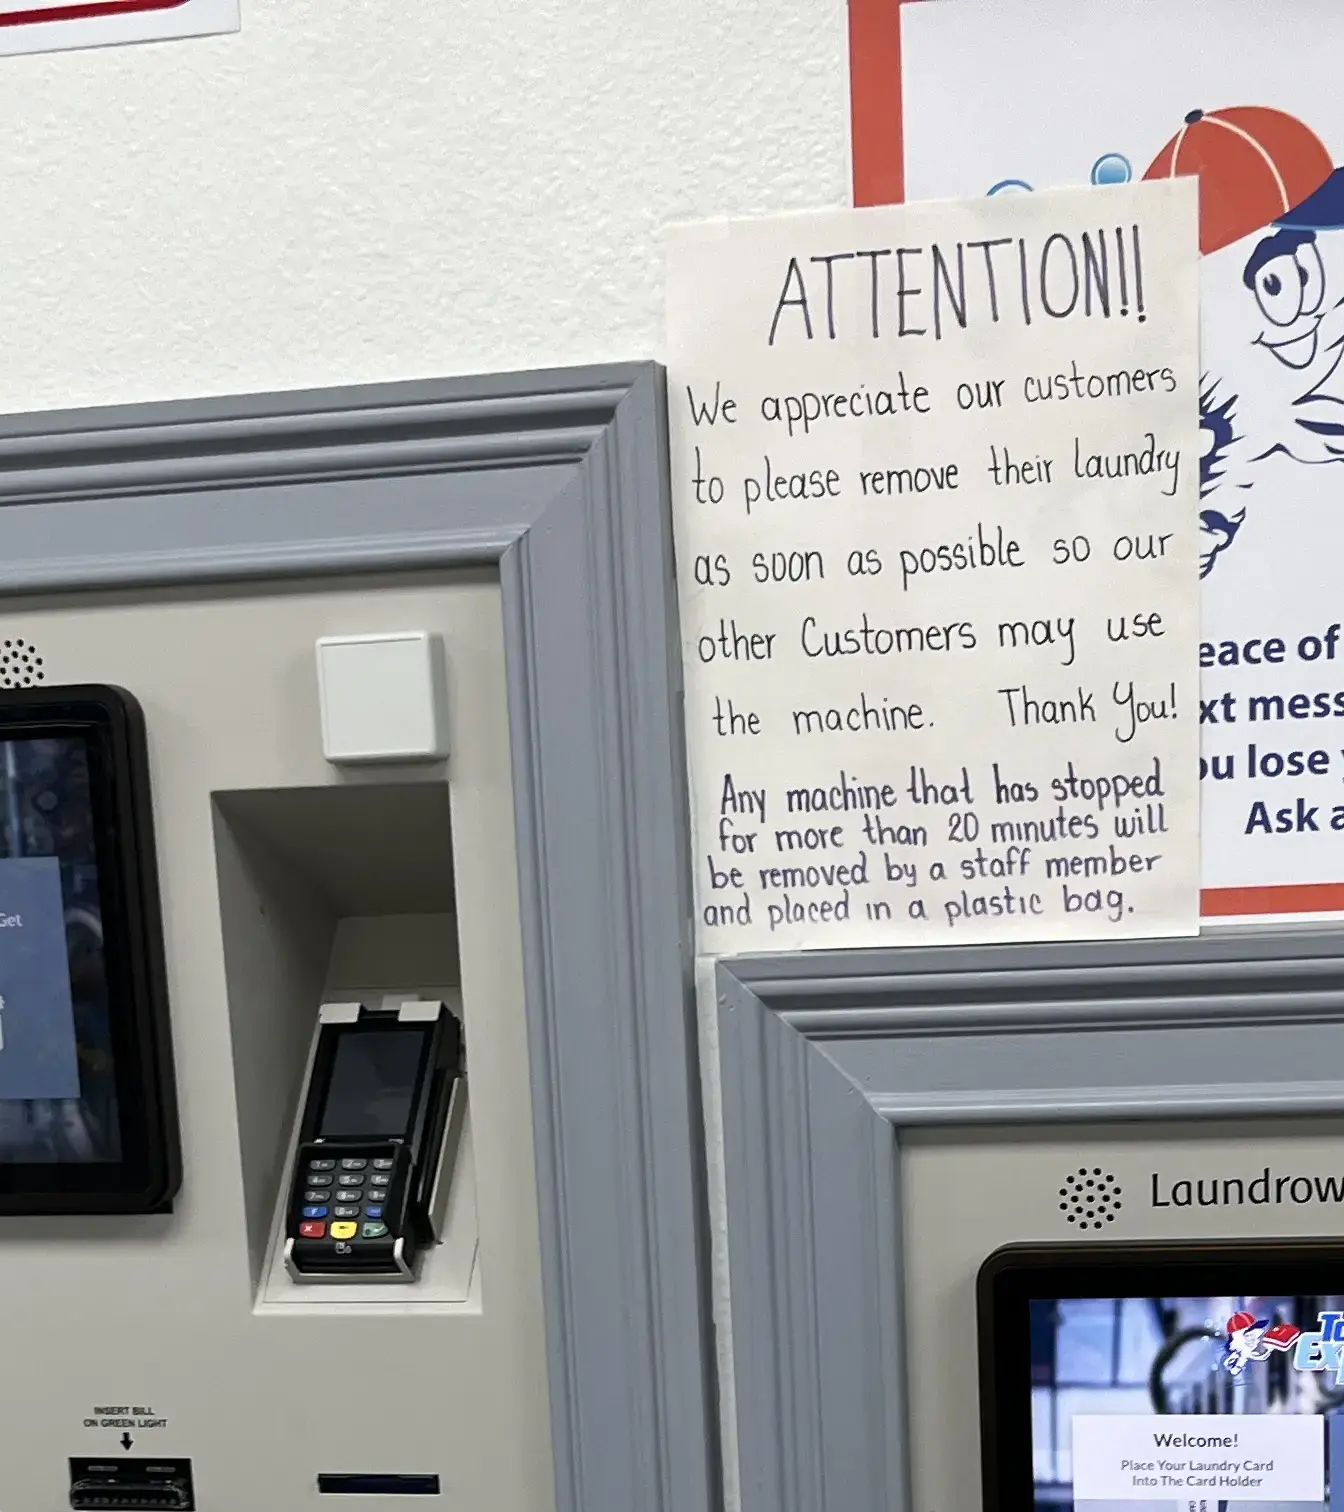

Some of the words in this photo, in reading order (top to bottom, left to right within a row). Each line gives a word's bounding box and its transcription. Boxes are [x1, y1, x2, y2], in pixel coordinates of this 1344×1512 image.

[767, 222, 1148, 347] ATTENTION!!
[685, 380, 738, 428] We
[760, 369, 932, 438] appreciate
[955, 379, 1007, 411] our
[1023, 359, 1178, 404] customers
[690, 444, 725, 505] to
[743, 456, 842, 516] please
[858, 462, 960, 497] remove
[986, 444, 1055, 487] their
[1073, 431, 1182, 498] laundry
[693, 553, 732, 588] as
[751, 550, 826, 584] soon
[846, 548, 883, 577] as
[898, 521, 1027, 592] possible
[1051, 534, 1092, 565] so
[1112, 532, 1174, 562] our
[696, 618, 778, 665] other
[800, 611, 978, 659] Customers
[997, 616, 1076, 668] may
[1106, 611, 1167, 642] use
[1199, 636, 1287, 669] eace
[1296, 622, 1342, 663] of
[711, 694, 762, 738] the
[792, 690, 935, 735] machine.
[997, 684, 1098, 728] Thank
[1111, 680, 1179, 744] You!
[1247, 742, 1331, 780] lose
[719, 772, 767, 825] Any
[785, 768, 899, 813] machine
[906, 764, 975, 807] that
[993, 762, 1040, 805] has
[1050, 756, 1165, 811] stopped
[1243, 796, 1321, 836] Ask
[717, 816, 759, 855] for
[775, 825, 845, 851] more
[861, 812, 929, 847] than
[947, 811, 980, 844] 20
[990, 811, 1100, 843] minutes
[1113, 801, 1170, 838] will
[706, 854, 745, 891] be
[758, 849, 871, 891] removed
[884, 851, 918, 885] by
[928, 861, 948, 883] a
[959, 845, 1033, 881] staff
[1045, 843, 1163, 879] member
[702, 890, 753, 928] and
[767, 889, 851, 929] placed
[865, 900, 893, 921] in
[907, 898, 928, 921] a
[944, 885, 1044, 928] plastic
[1061, 883, 1135, 921] bag.
[1154, 1433, 1238, 1448] Welcome!
[1121, 1460, 1154, 1471] Place
[1156, 1460, 1186, 1471] Your
[1189, 1460, 1240, 1473] Laundry
[1243, 1460, 1274, 1471] Card
[1132, 1475, 1157, 1486] Into
[1160, 1475, 1184, 1486] The
[1186, 1476, 1216, 1487] Card
[1219, 1476, 1263, 1487] Holder
